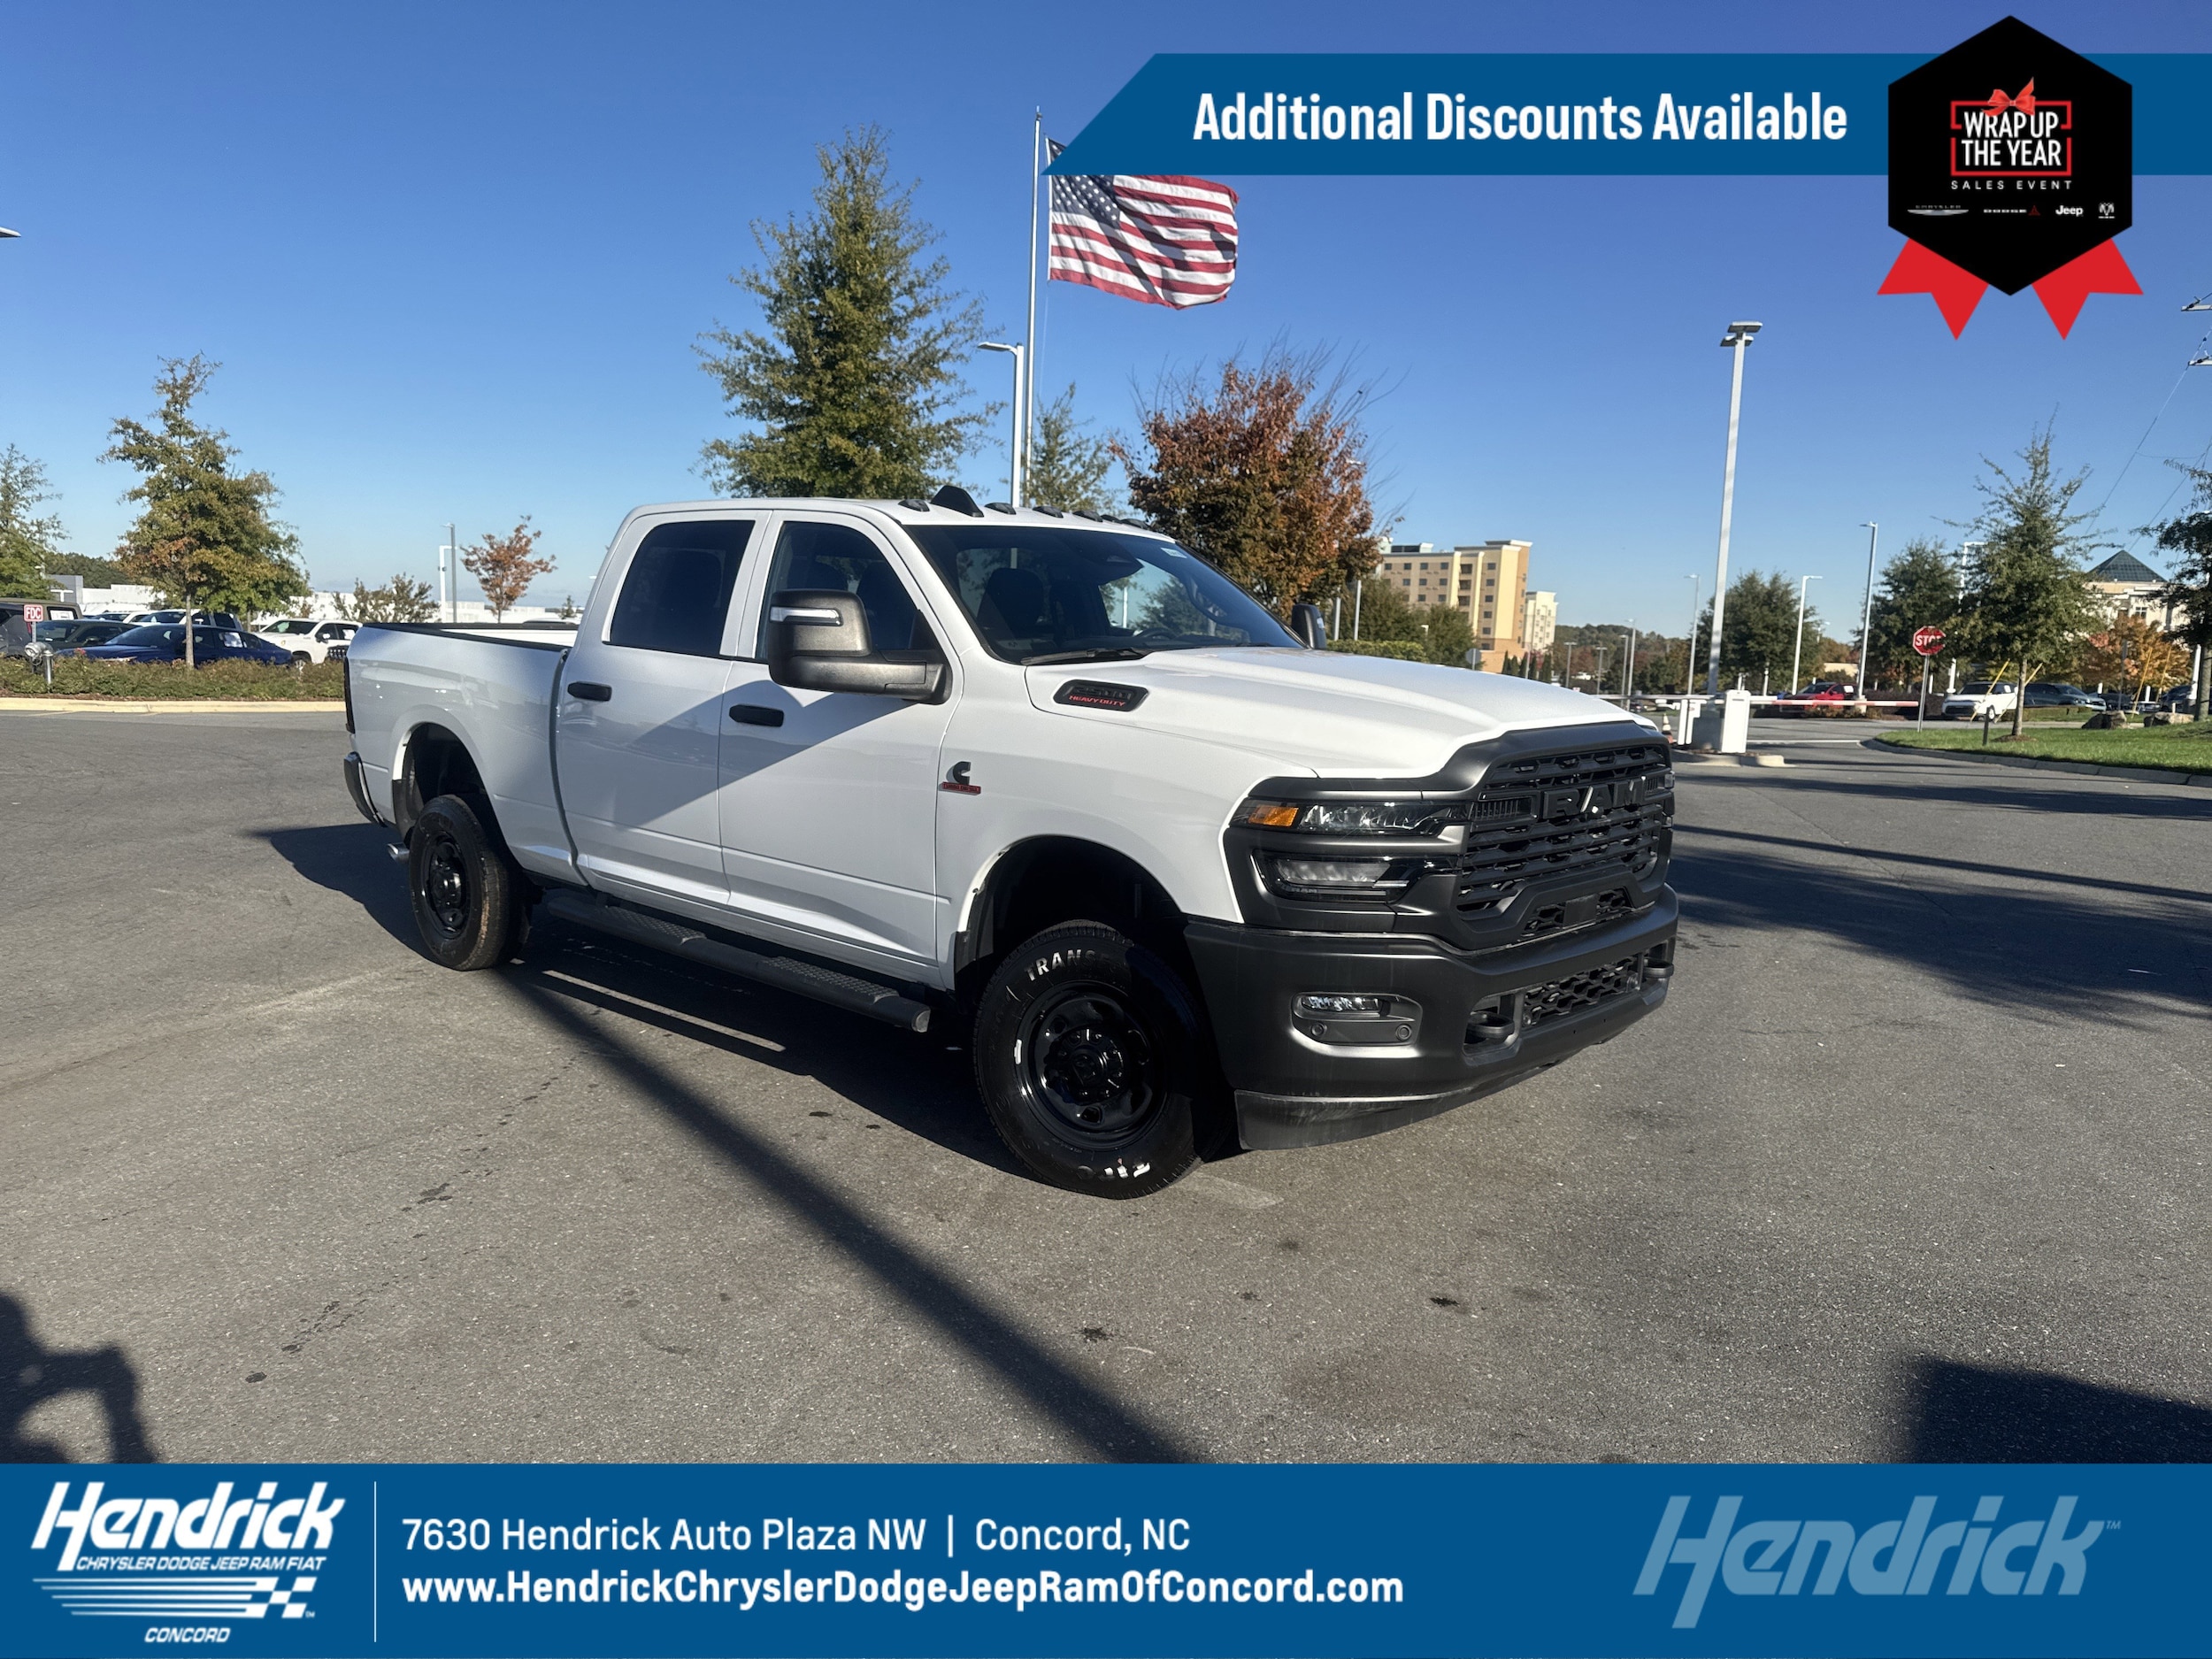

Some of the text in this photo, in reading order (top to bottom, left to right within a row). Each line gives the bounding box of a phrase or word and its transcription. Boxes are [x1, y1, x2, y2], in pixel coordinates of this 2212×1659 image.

[26, 607, 42, 619] FDC
[1916, 634, 1941, 646] STO
[1099, 698, 1126, 707] DUTY
[1543, 778, 1646, 819] RAM
